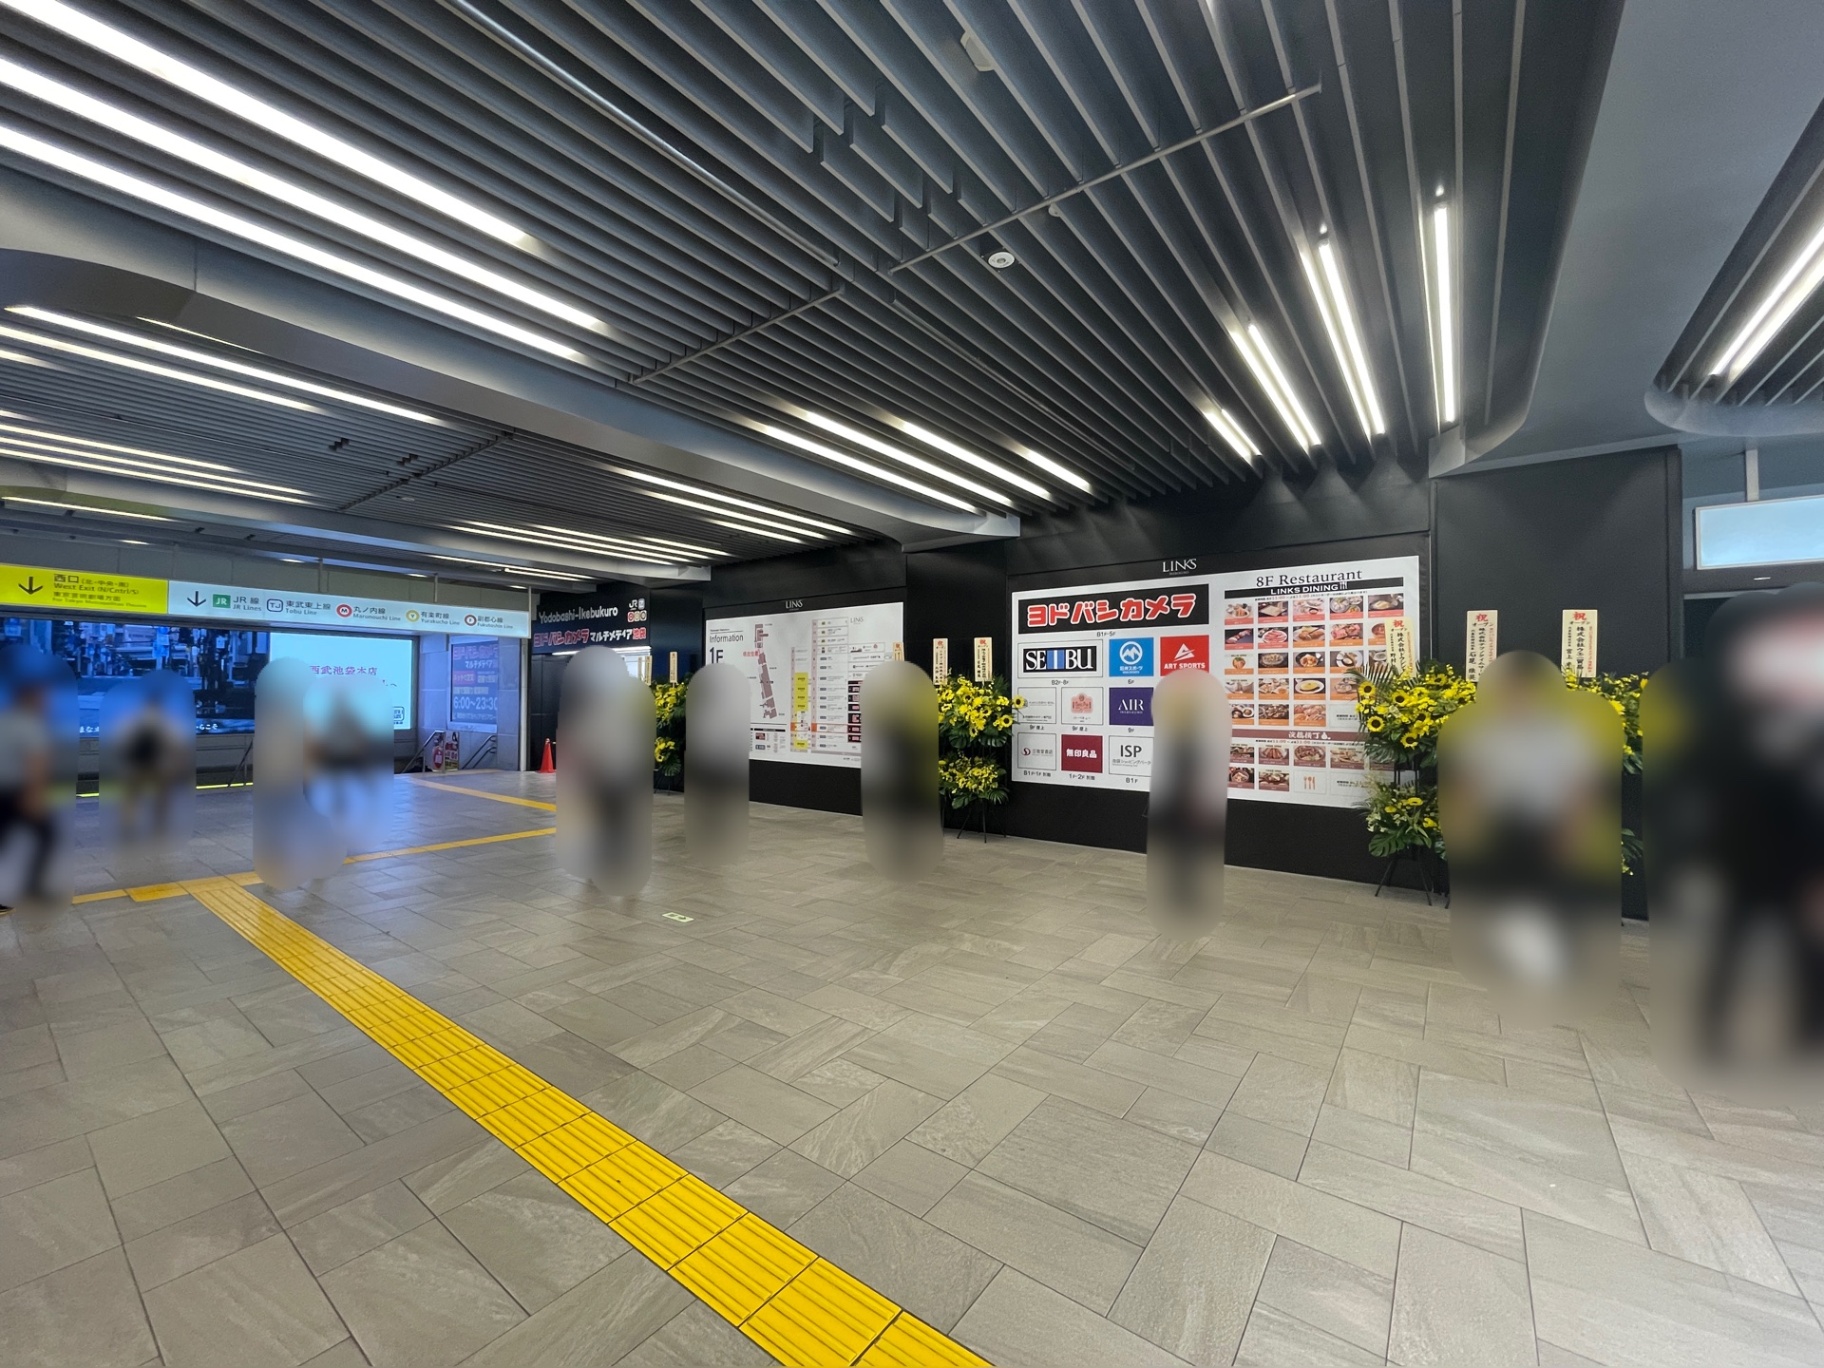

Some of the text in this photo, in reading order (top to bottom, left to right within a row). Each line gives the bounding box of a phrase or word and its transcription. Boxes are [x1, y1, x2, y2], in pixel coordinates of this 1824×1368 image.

[1162, 558, 1197, 572] LINKS
[54, 574, 79, 583] 西口
[1256, 570, 1363, 587] 8F Restaurant
[1270, 584, 1339, 595] LINKS DINING
[215, 597, 227, 605] JR
[233, 596, 260, 605] JR 線
[286, 600, 331, 610] 東武東上線
[353, 607, 386, 615] 丸ノ内線
[421, 611, 449, 620] 有楽町線
[538, 606, 619, 624] Yodobashi-Ikebukuro
[1028, 593, 1197, 628] ヨドバシカメラ
[1573, 611, 1587, 620] 祝
[477, 615, 504, 623] 副都心線
[1476, 613, 1488, 621] 祝
[1393, 620, 1404, 628] 祝
[709, 634, 744, 643] Information
[1025, 648, 1094, 670] SEIBU
[309, 665, 377, 675] 西武池袋本店
[1118, 699, 1144, 711] AIR
[1066, 748, 1097, 759] 無印良品
[1120, 745, 1142, 757] ISP
